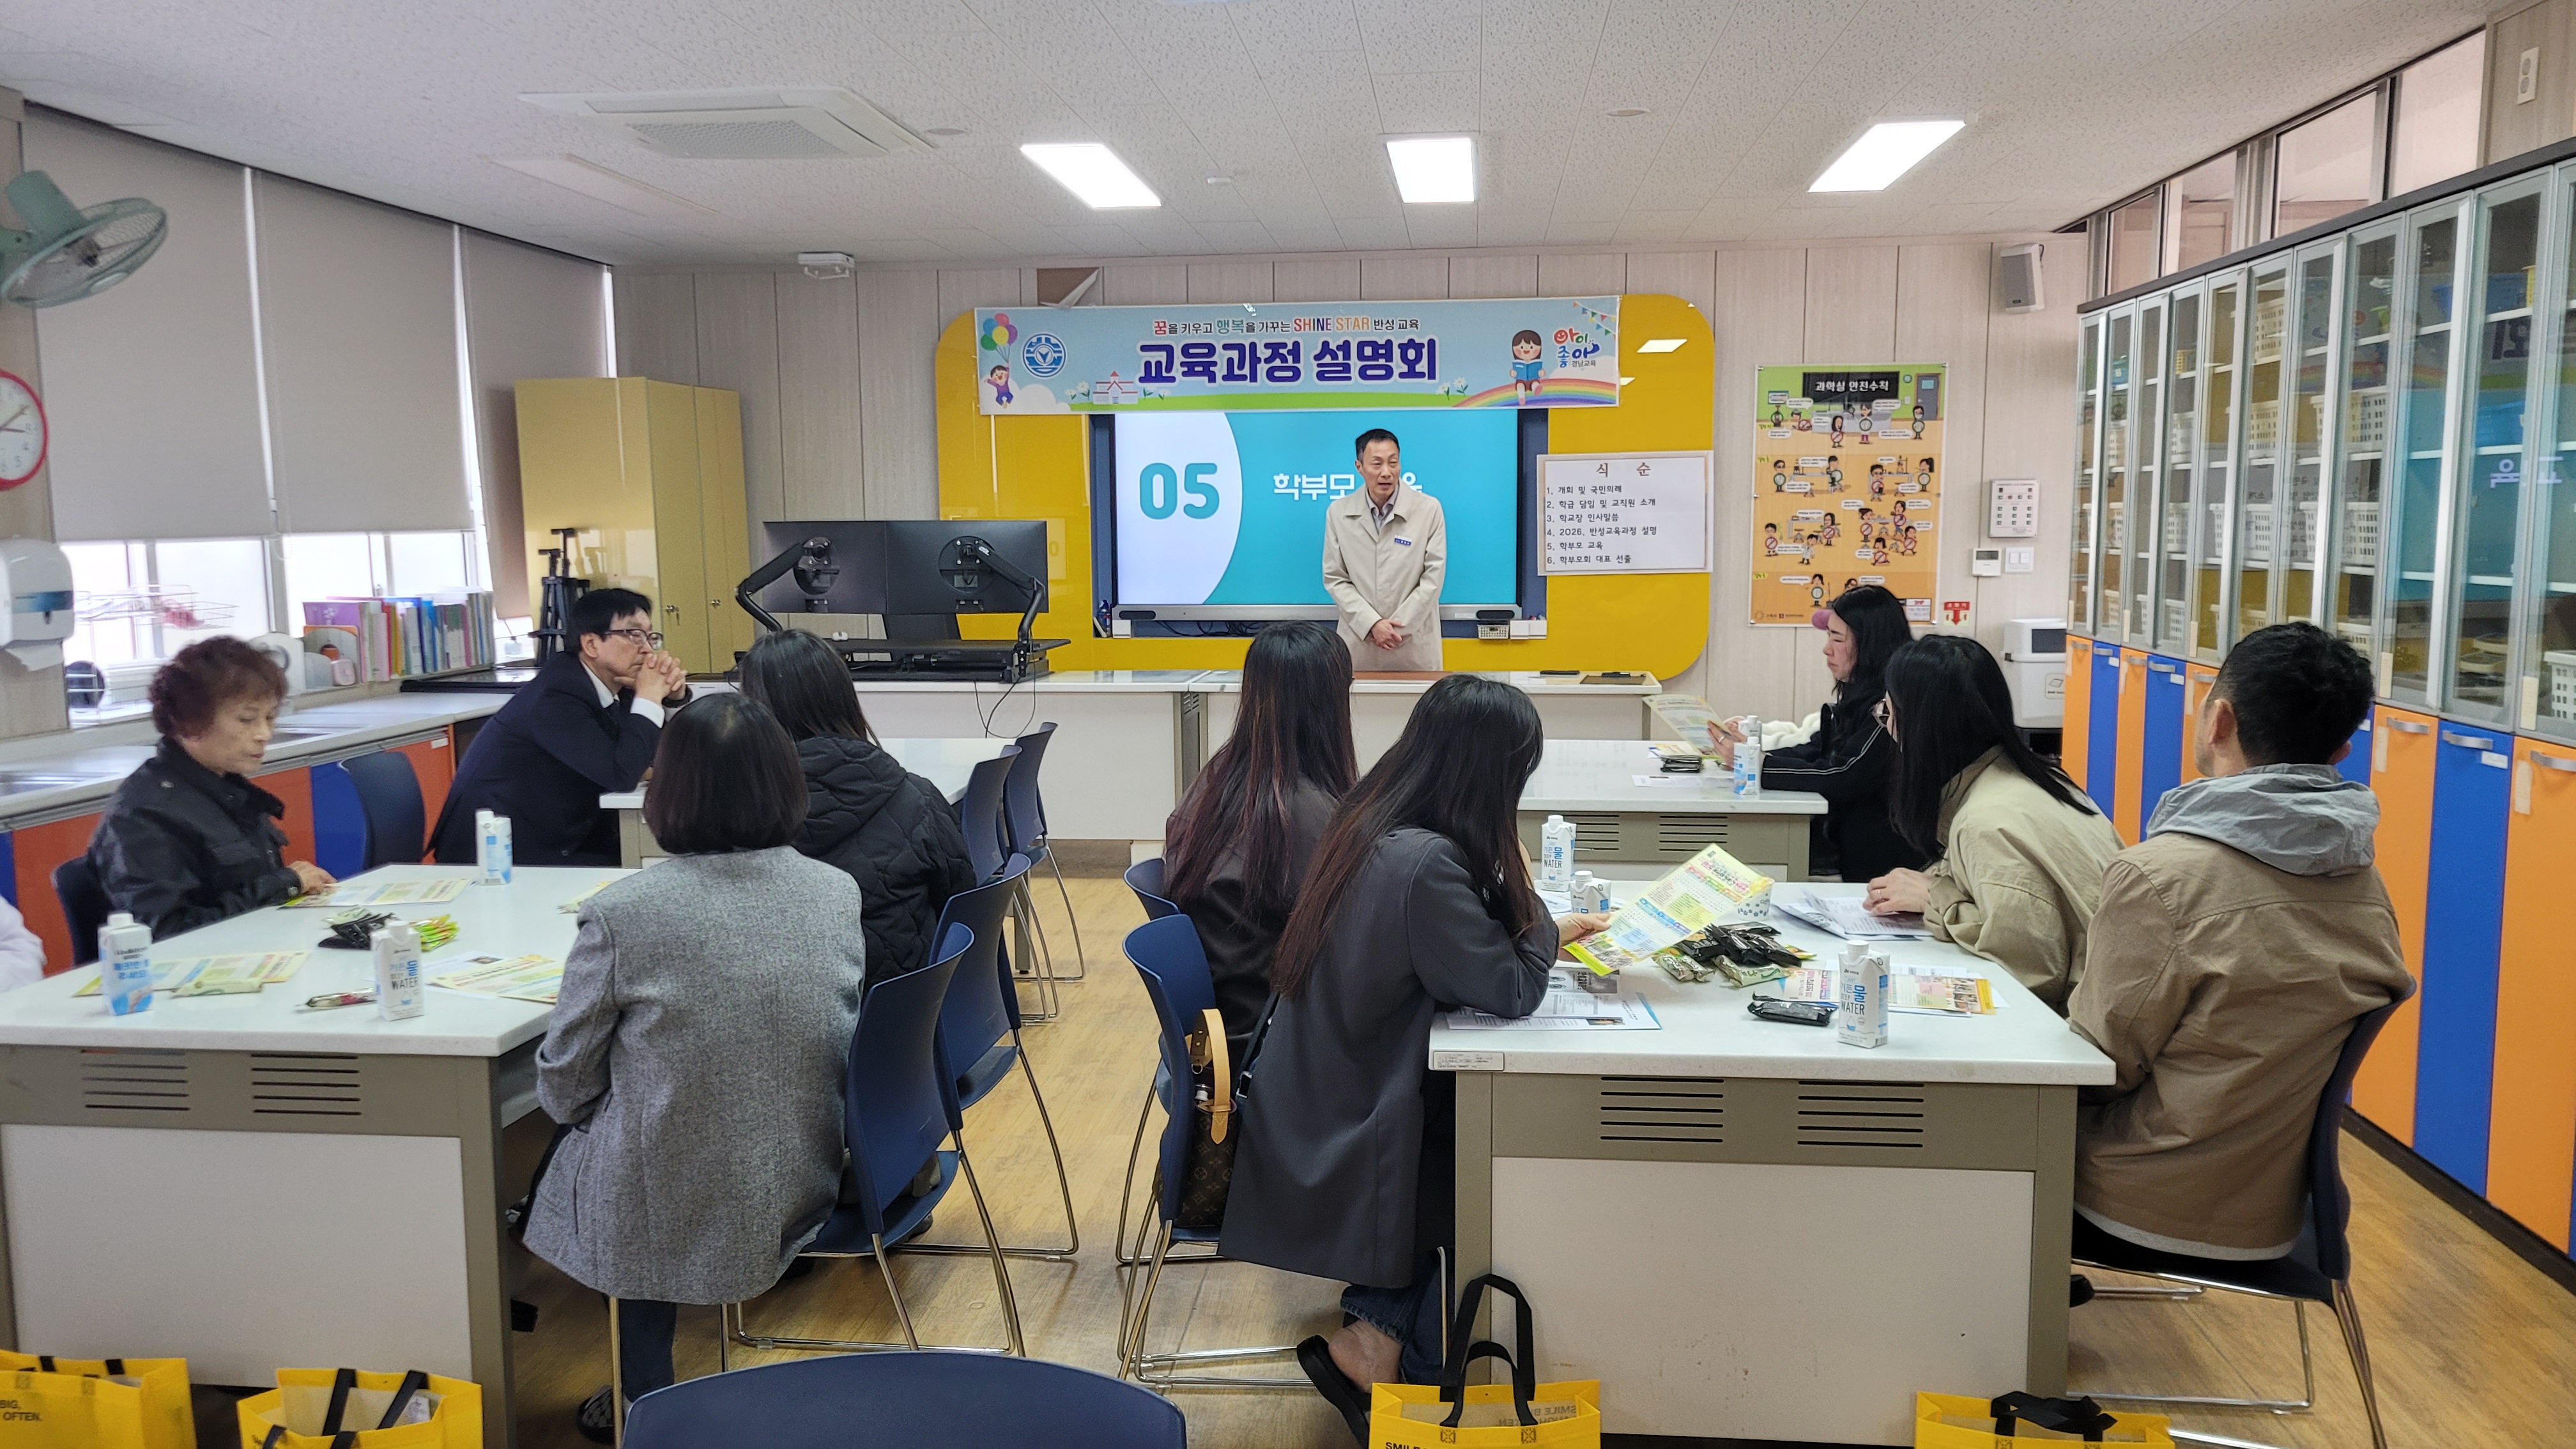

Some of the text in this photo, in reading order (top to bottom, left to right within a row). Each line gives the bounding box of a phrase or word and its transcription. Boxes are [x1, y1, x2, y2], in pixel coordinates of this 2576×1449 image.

[1154, 317, 1419, 335] 꿈을 키우고 행복을 가꾸는 SHINE STAR 반성 교육
[1554, 328, 1588, 344] 아이
[1138, 338, 1436, 383] 교육과정 설명회
[1558, 343, 1600, 368] 좋아
[1815, 379, 1889, 392] 과학실 안전수칙
[1139, 463, 1220, 519] 05
[1273, 473, 1354, 501] 학부모
[1578, 486, 1586, 495] 및
[1590, 485, 1622, 494] 국민의례
[1559, 500, 1574, 509] 학급
[1579, 500, 1595, 509] 담임
[1600, 499, 1607, 509] 및
[1611, 498, 1635, 507] 교직원
[1560, 514, 1583, 523] 학교장
[1588, 513, 1619, 523] 인사말씀
[1590, 526, 1637, 537] 반성교육과정
[1641, 526, 1657, 535] 설명
[1560, 542, 1583, 551] 학부모
[1588, 541, 1604, 550] 교육
[1547, 555, 1631, 565] 6. 학부모회 대표 선출
[1544, 859, 1562, 868] WATER
[391, 976, 419, 990] WATER
[1841, 1000, 1865, 1015] WATER
